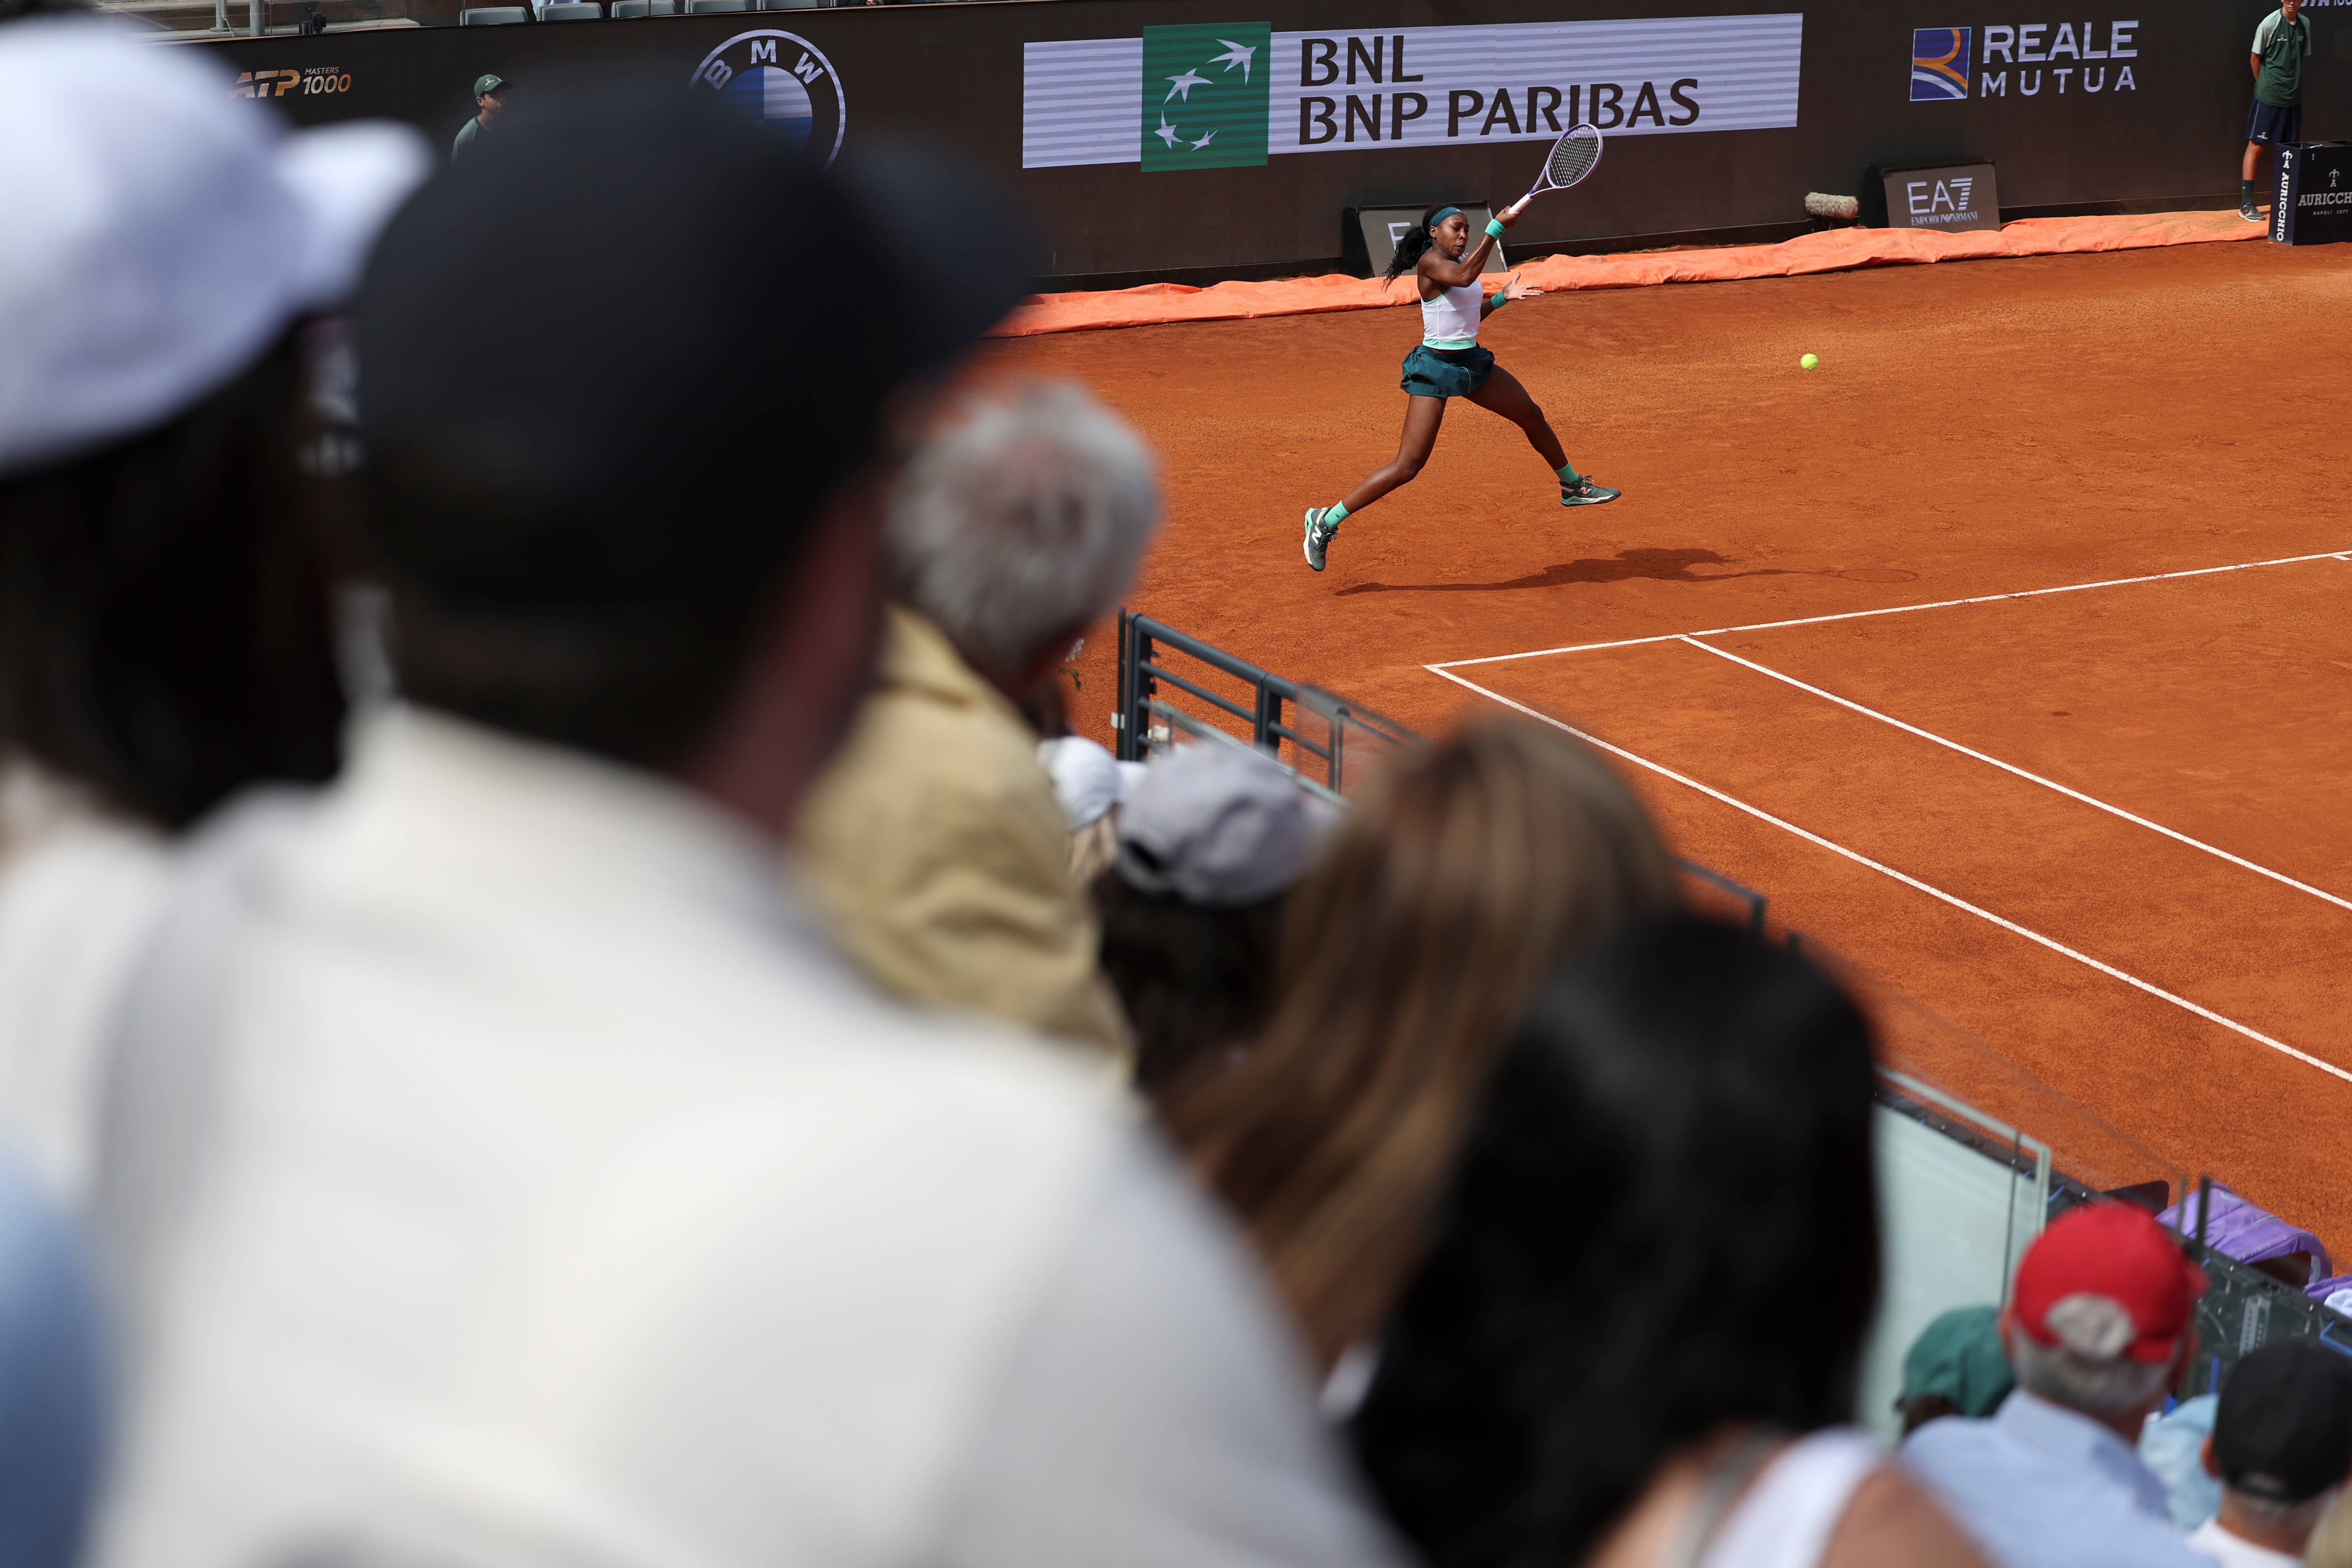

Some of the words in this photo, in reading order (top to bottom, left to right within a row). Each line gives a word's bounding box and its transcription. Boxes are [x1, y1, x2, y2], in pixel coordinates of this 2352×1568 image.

[1300, 35, 1423, 86] BNL
[1983, 20, 2139, 64] REALE
[226, 69, 300, 99] ATP
[303, 74, 351, 94] 1000
[704, 40, 824, 91] BMW
[1981, 66, 2136, 98] MUTUA
[1299, 93, 1428, 145] BNP
[1447, 78, 1699, 137] PARIBAS
[1907, 178, 1973, 214] EA7
[2276, 172, 2290, 241] AURICCHIO
[1911, 215, 1943, 225] EMPORIO
[1951, 212, 1978, 223] ARMANI
